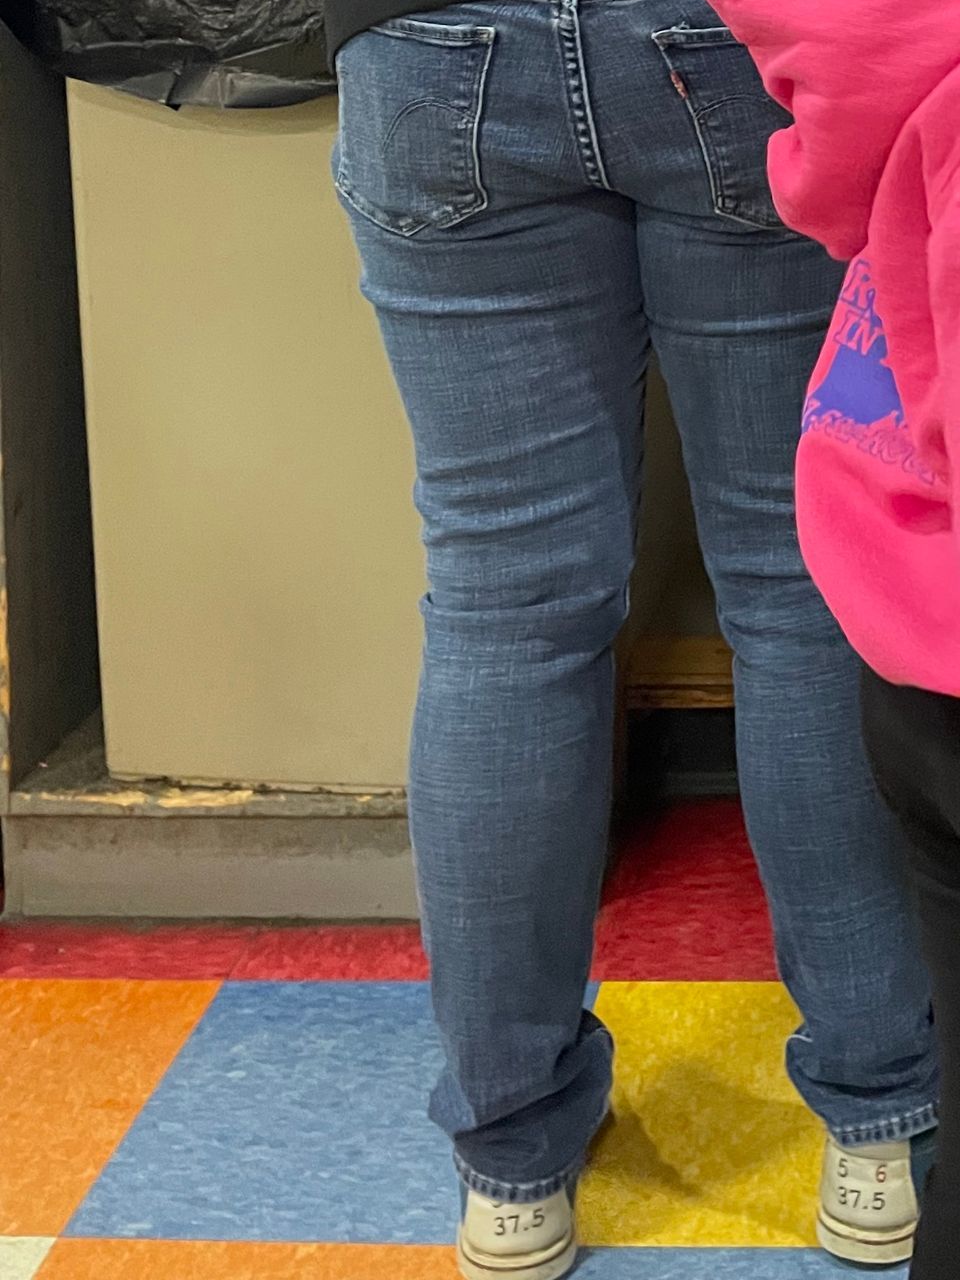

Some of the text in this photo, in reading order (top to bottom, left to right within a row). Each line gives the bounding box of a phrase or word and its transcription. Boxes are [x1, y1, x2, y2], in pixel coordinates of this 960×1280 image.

[837, 1158, 887, 1183] 5 6
[838, 1186, 886, 1210] 37.5
[494, 1208, 545, 1236] 37.5
